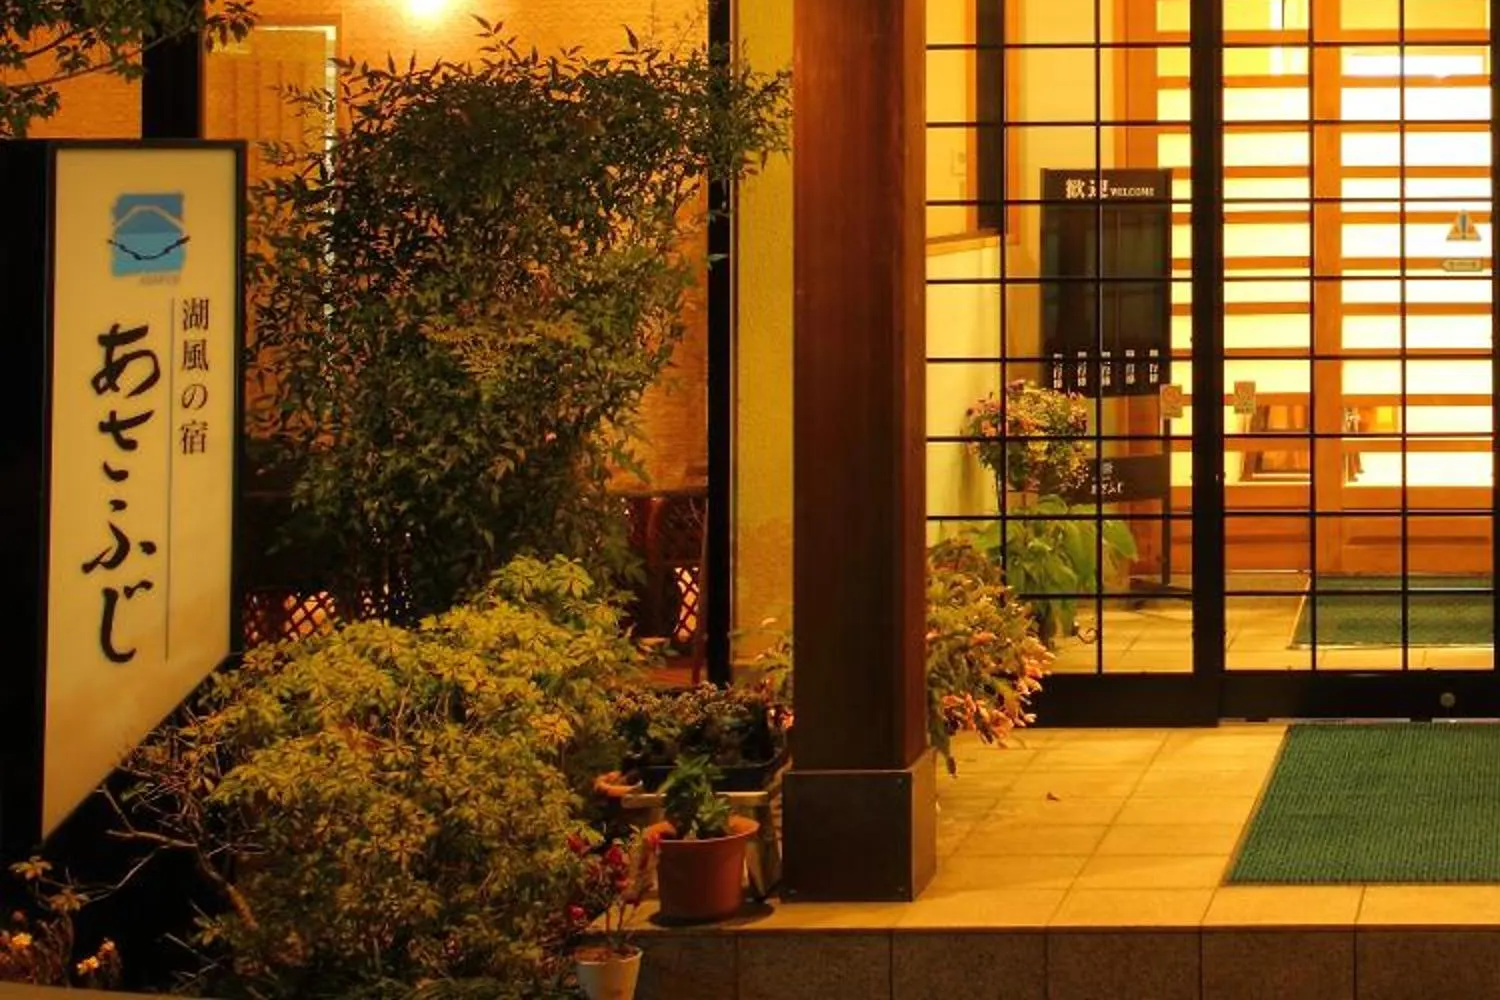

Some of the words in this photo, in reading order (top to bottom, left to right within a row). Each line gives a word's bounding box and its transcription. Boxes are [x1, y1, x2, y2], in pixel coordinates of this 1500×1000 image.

[1109, 186, 1155, 197] WELCOME
[179, 297, 210, 456] 湖風の宿
[81, 322, 162, 665] あさふじ
